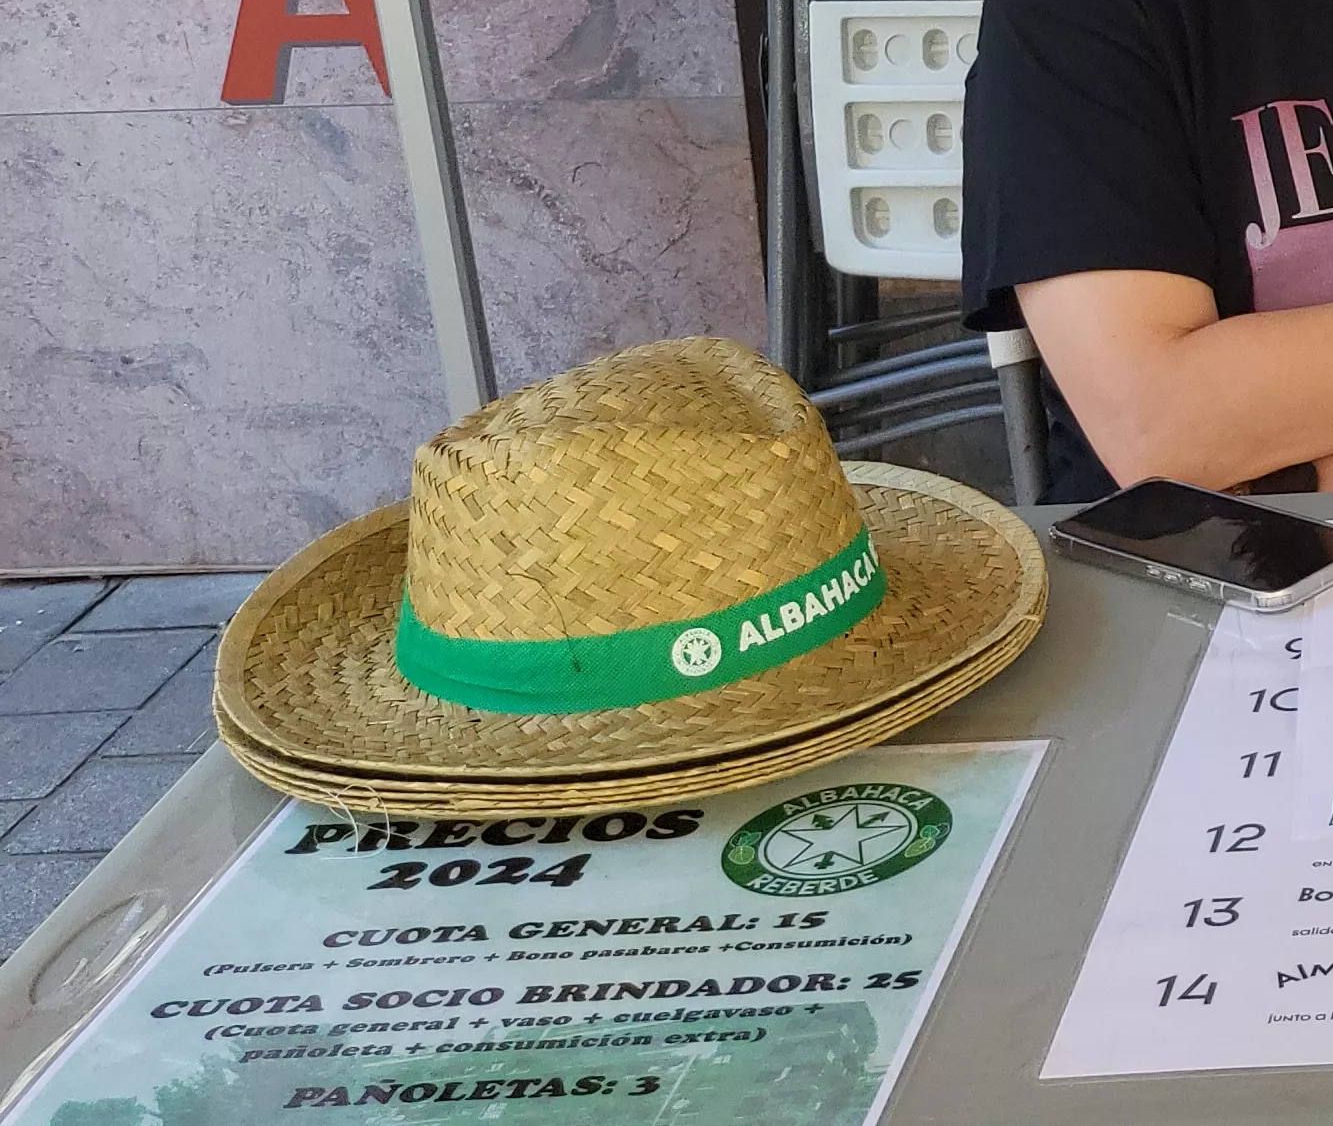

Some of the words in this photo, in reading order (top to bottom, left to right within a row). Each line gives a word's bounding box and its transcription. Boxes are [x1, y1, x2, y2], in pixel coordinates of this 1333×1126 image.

[739, 551, 876, 652] ALBAHACA
[1239, 750, 1282, 779] 11
[782, 786, 934, 816] ALBAHACA
[284, 810, 704, 854] PRECIOS
[1206, 823, 1267, 853] 12
[366, 853, 592, 890] 2024
[746, 869, 883, 896] REBERDE
[322, 924, 490, 948] CUOTA
[508, 913, 761, 940] GENERAL:
[772, 910, 830, 930] 15
[1183, 897, 1244, 928] 13
[203, 962, 314, 977] (Pulsera
[345, 953, 475, 969] Sombrero
[506, 949, 574, 962] Bono
[579, 943, 711, 961] pasabares
[150, 994, 325, 1019] CUOTA
[341, 987, 505, 1011] SOCIO
[516, 973, 851, 1005] BRINDADOR:
[863, 970, 923, 990] 25
[1156, 973, 1218, 1007] 14
[204, 1022, 321, 1041] (Cuota
[326, 1016, 461, 1038] general
[500, 1013, 572, 1028] vaso
[612, 1005, 795, 1025] cuelgavaso
[238, 1043, 394, 1064] pañoleta
[434, 1027, 652, 1053] consumición
[663, 1026, 768, 1045] extra)
[282, 1076, 618, 1109] PAÑOLETAS:
[627, 1076, 662, 1096] 3
